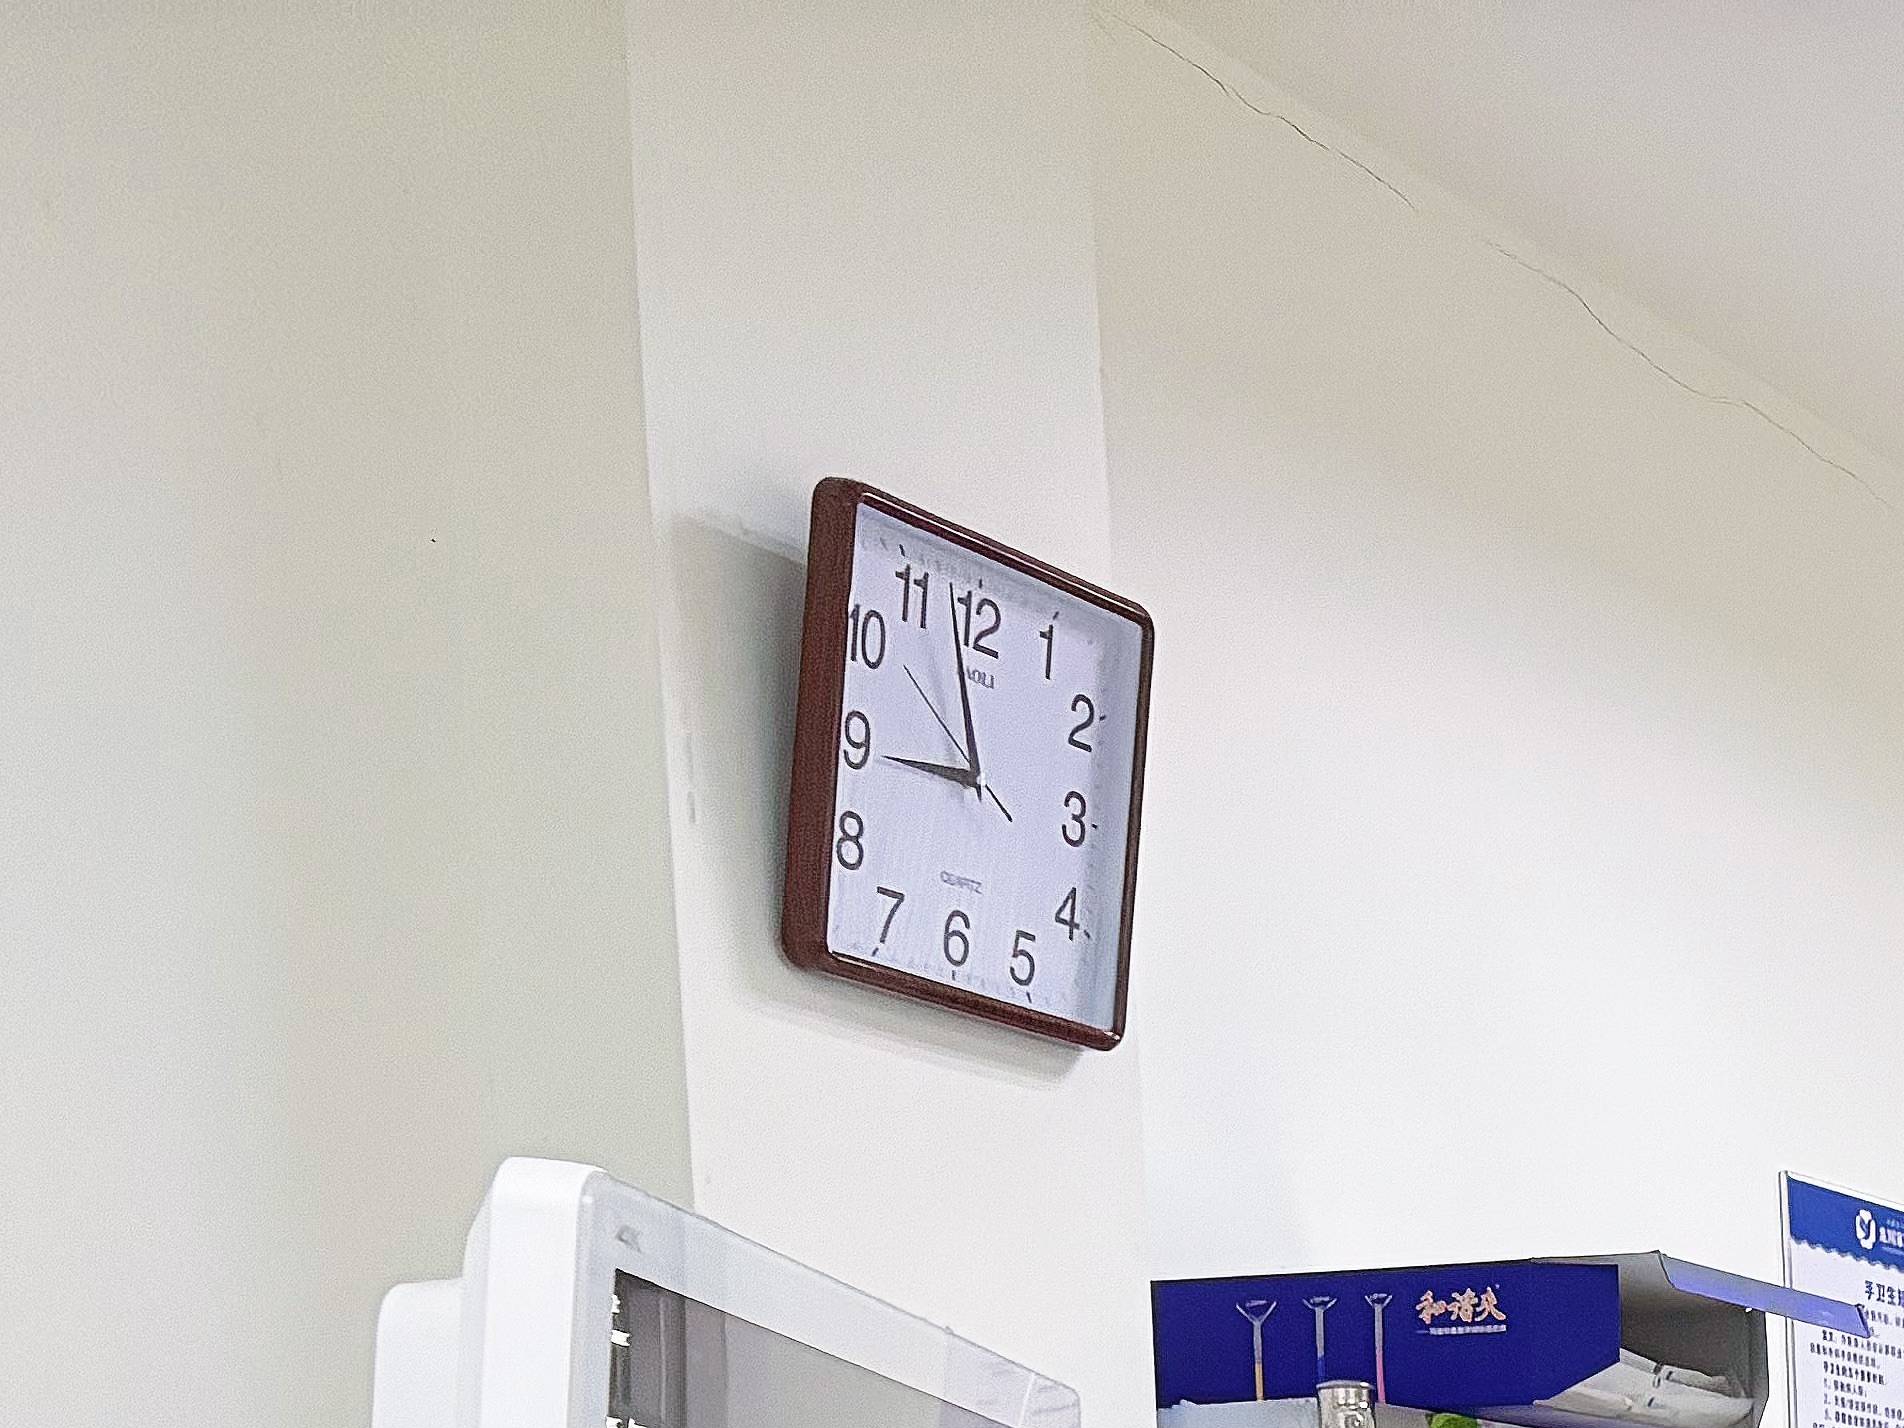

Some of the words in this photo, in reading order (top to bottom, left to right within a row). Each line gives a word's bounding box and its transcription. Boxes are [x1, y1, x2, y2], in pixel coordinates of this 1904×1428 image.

[895, 564, 929, 630] 11
[956, 590, 999, 660] 12
[850, 603, 886, 670] 10
[1039, 623, 1054, 680] 1
[843, 711, 871, 770] 9
[1068, 693, 1096, 753] 2
[836, 810, 865, 871] 8
[1061, 791, 1087, 847] 3
[876, 885, 905, 944] 7
[943, 908, 970, 967] 6
[1054, 886, 1080, 941] 4
[1009, 930, 1037, 987] 5
